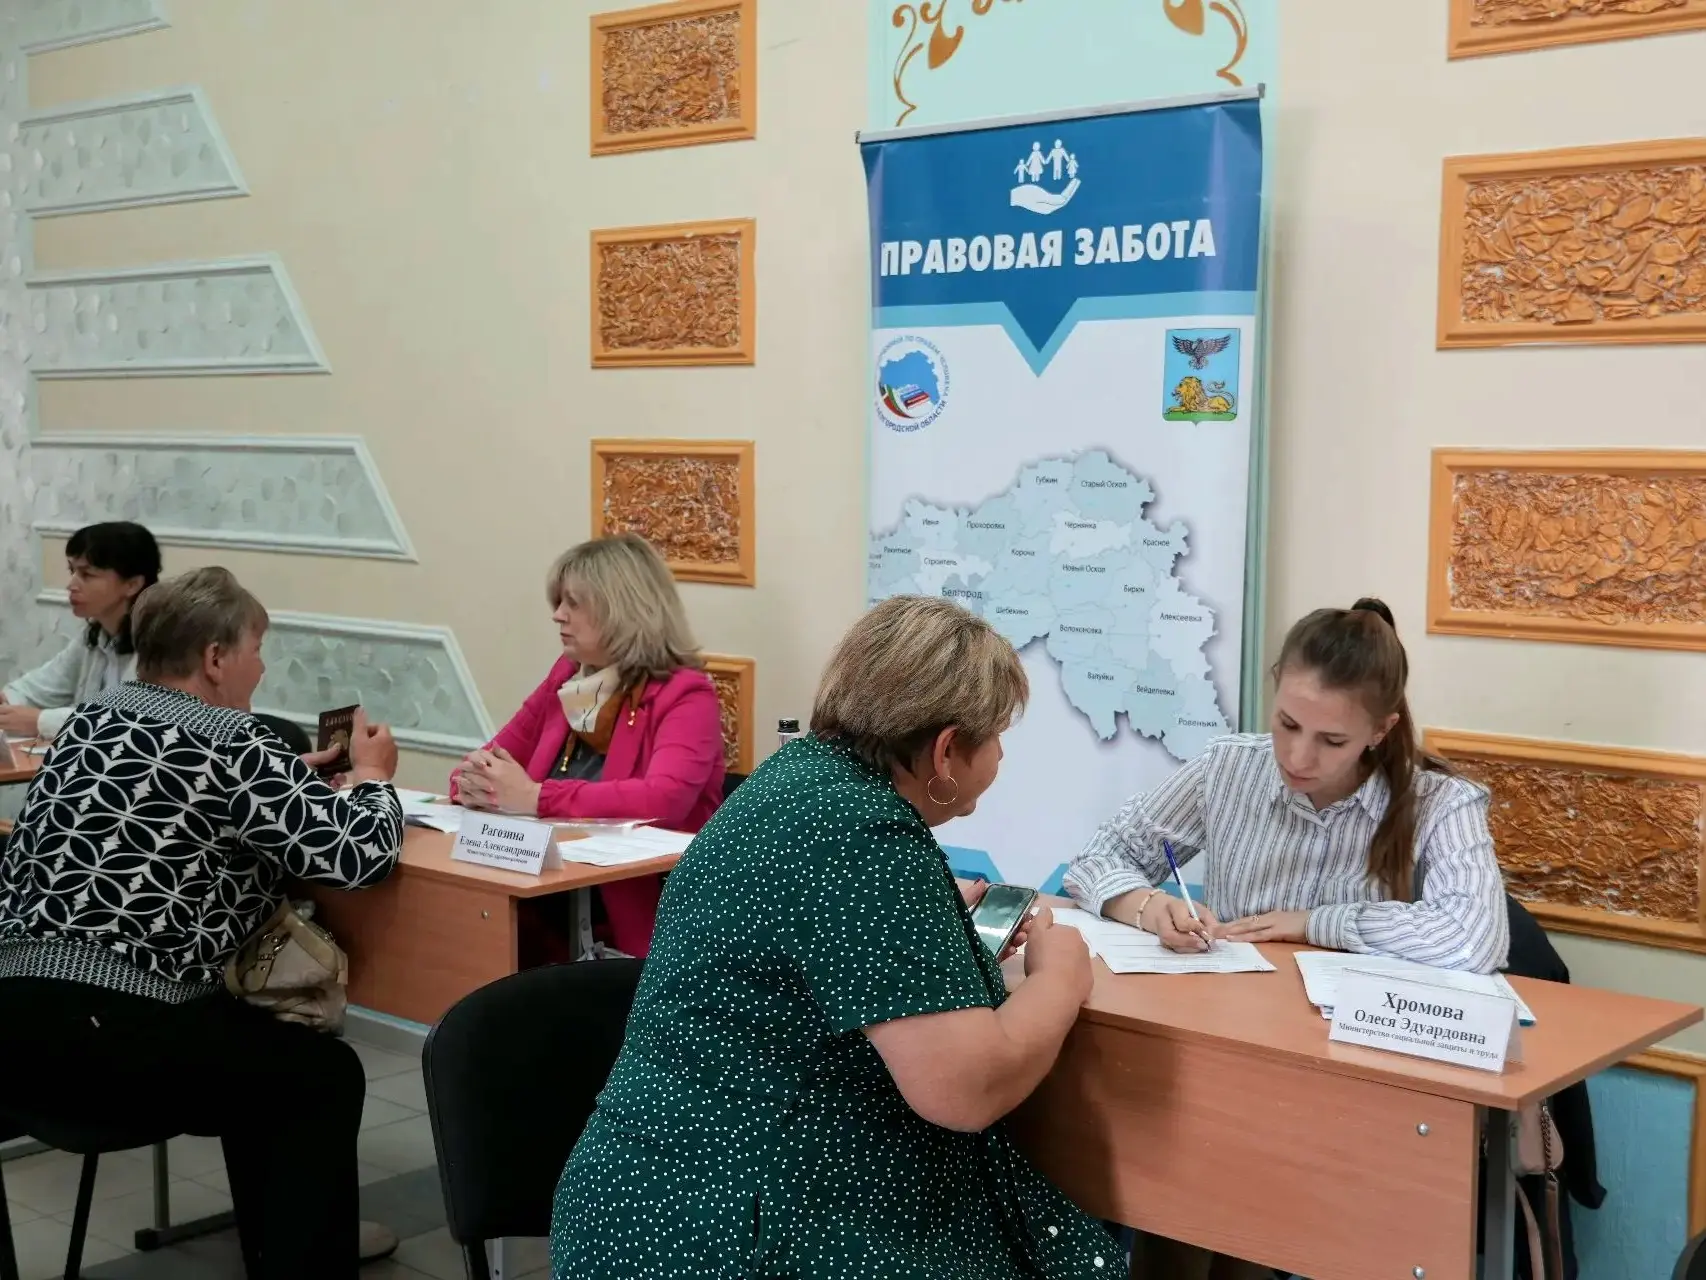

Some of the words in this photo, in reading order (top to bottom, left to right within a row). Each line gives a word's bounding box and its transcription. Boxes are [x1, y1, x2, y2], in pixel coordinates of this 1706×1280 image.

[880, 230, 1062, 277] ПРАВОВАЯ
[1074, 219, 1216, 266] ЗАБОТА
[920, 400, 947, 429] ОБЛАСТИ
[1035, 476, 1058, 484] Губкин
[1081, 480, 1106, 489] Старый
[1107, 481, 1127, 489] Оскол
[966, 521, 1006, 530] Прохоровка
[1064, 521, 1097, 530] Чернянка
[1142, 538, 1170, 547] Красное
[1011, 549, 1036, 557] Короча
[923, 557, 958, 566] Строитель
[1062, 563, 1085, 572] Новый
[1085, 565, 1106, 574] Оскол
[941, 587, 983, 599] Белгород
[1159, 612, 1203, 623] Алексеевка
[1059, 624, 1103, 635] Волоконовка
[1087, 671, 1115, 682] Валуйки
[1136, 684, 1175, 697] Вейделевка
[1178, 717, 1218, 728] Ровеньки
[481, 823, 525, 842] Рагозина
[459, 835, 482, 848] Елена
[483, 840, 541, 859] Александровна
[1381, 991, 1464, 1021] Хромова
[1354, 1009, 1396, 1028] Олеся
[1400, 1017, 1486, 1045] Эдуардовна
[1338, 1022, 1390, 1039] Министерство
[1391, 1032, 1436, 1048] социальной
[1436, 1041, 1468, 1053] защиты
[1475, 1048, 1499, 1060] труда
